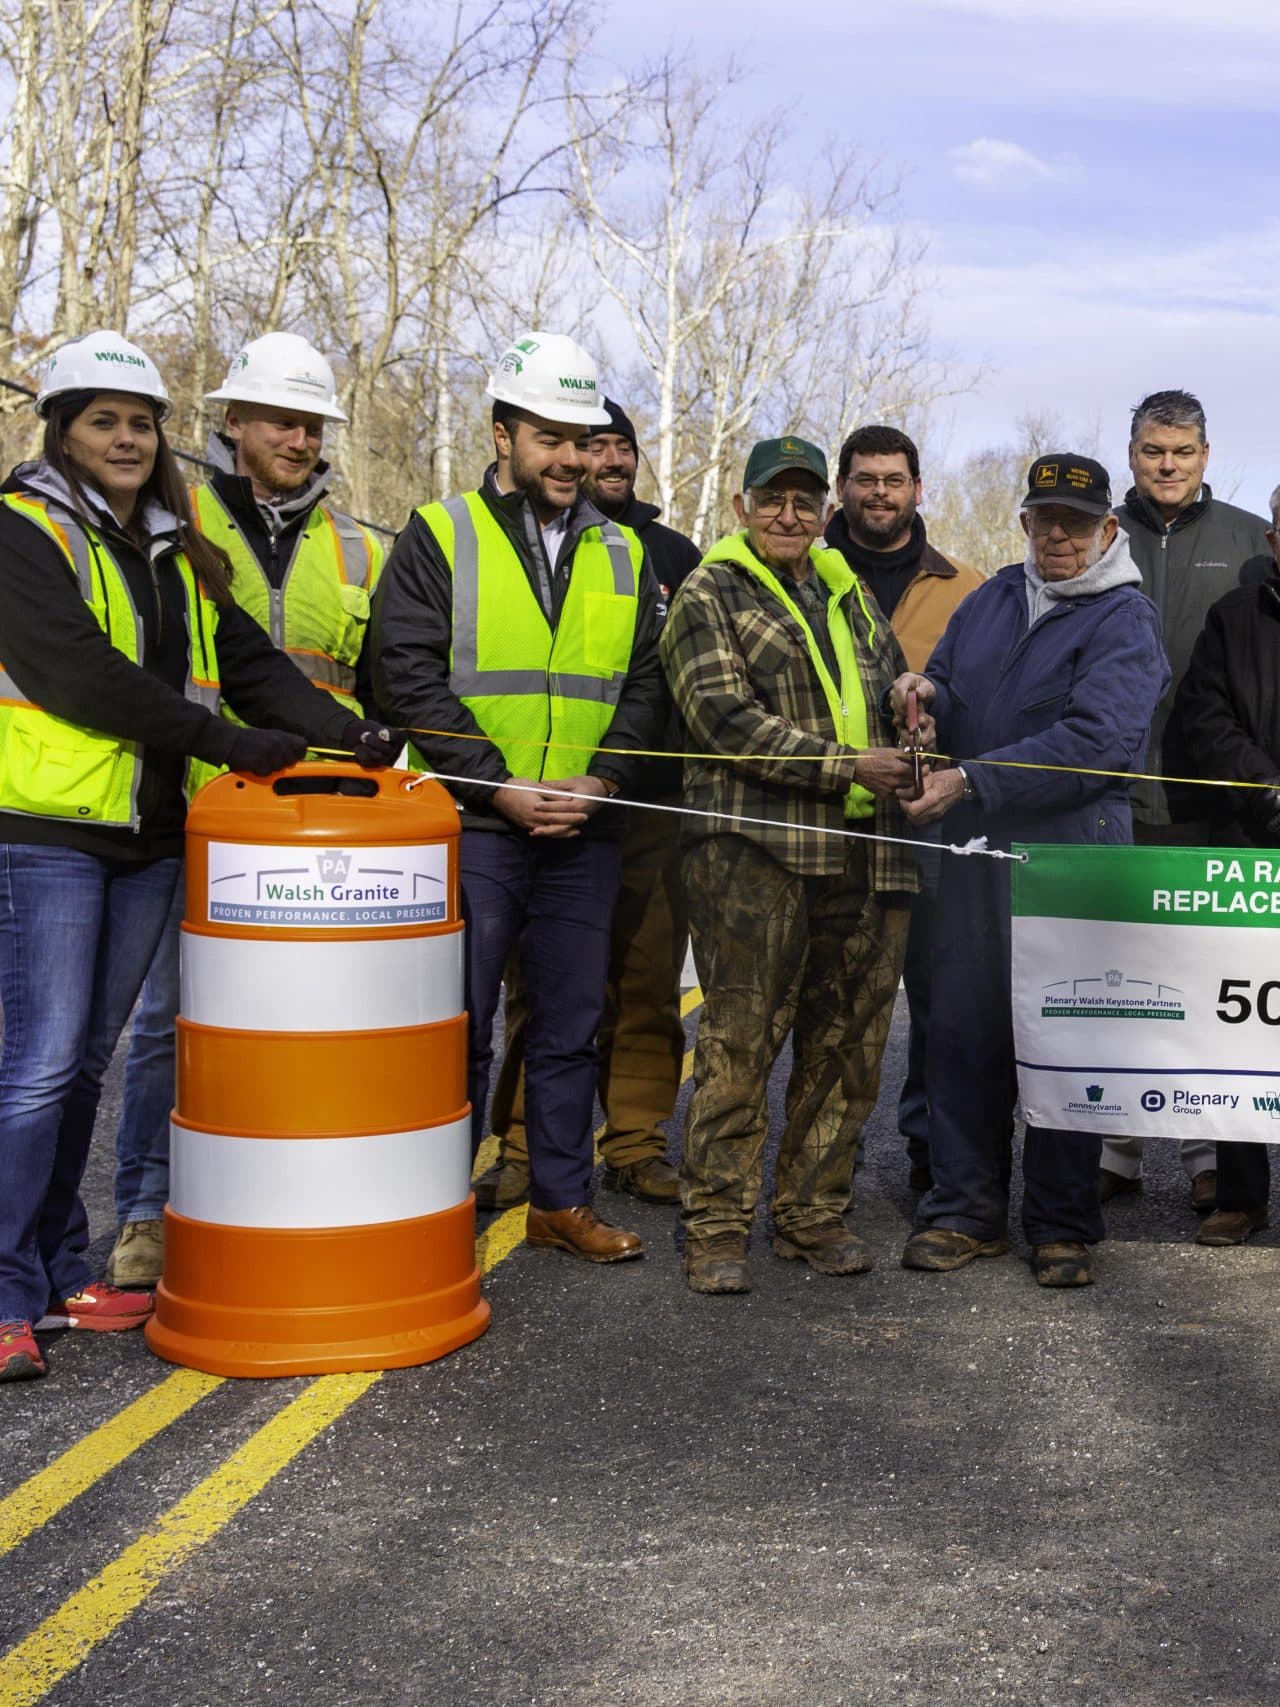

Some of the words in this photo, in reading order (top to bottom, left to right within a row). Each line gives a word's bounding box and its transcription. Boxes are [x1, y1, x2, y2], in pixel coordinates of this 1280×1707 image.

[94, 352, 146, 368] WALSH
[559, 377, 596, 390] WALSH
[322, 859, 347, 874] PA
[1206, 860, 1245, 883] PA
[266, 883, 324, 901] Walsh
[331, 884, 399, 901] Granite
[213, 906, 251, 919] PROVEN
[256, 910, 350, 921] PERFORMANCE.
[355, 909, 392, 920] LOCAL
[1108, 973, 1120, 983] PA
[1045, 996, 1077, 1006] Plenary
[1079, 997, 1104, 1005] Walsh
[1106, 998, 1145, 1007] Keystone
[1146, 999, 1182, 1008] Partners
[1068, 1102, 1122, 1112] pennsylvania
[1173, 1090, 1240, 1109] Plenary
[1172, 1105, 1202, 1115] Group
